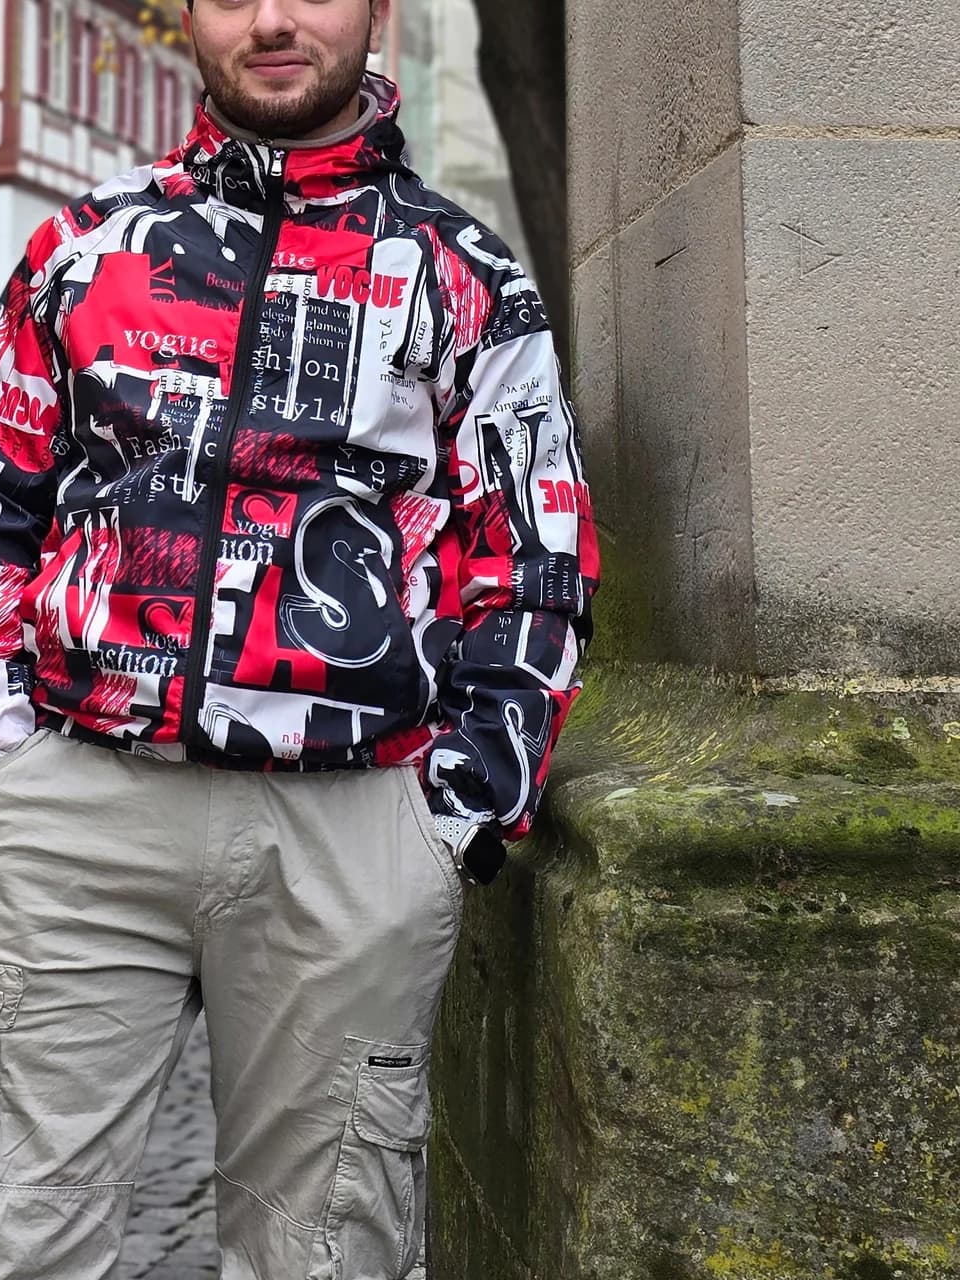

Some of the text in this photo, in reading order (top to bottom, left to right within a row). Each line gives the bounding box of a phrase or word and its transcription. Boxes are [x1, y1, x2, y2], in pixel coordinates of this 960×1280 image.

[316, 266, 409, 309] VOGUE
[123, 329, 218, 359] vogue
[252, 394, 344, 424] style
